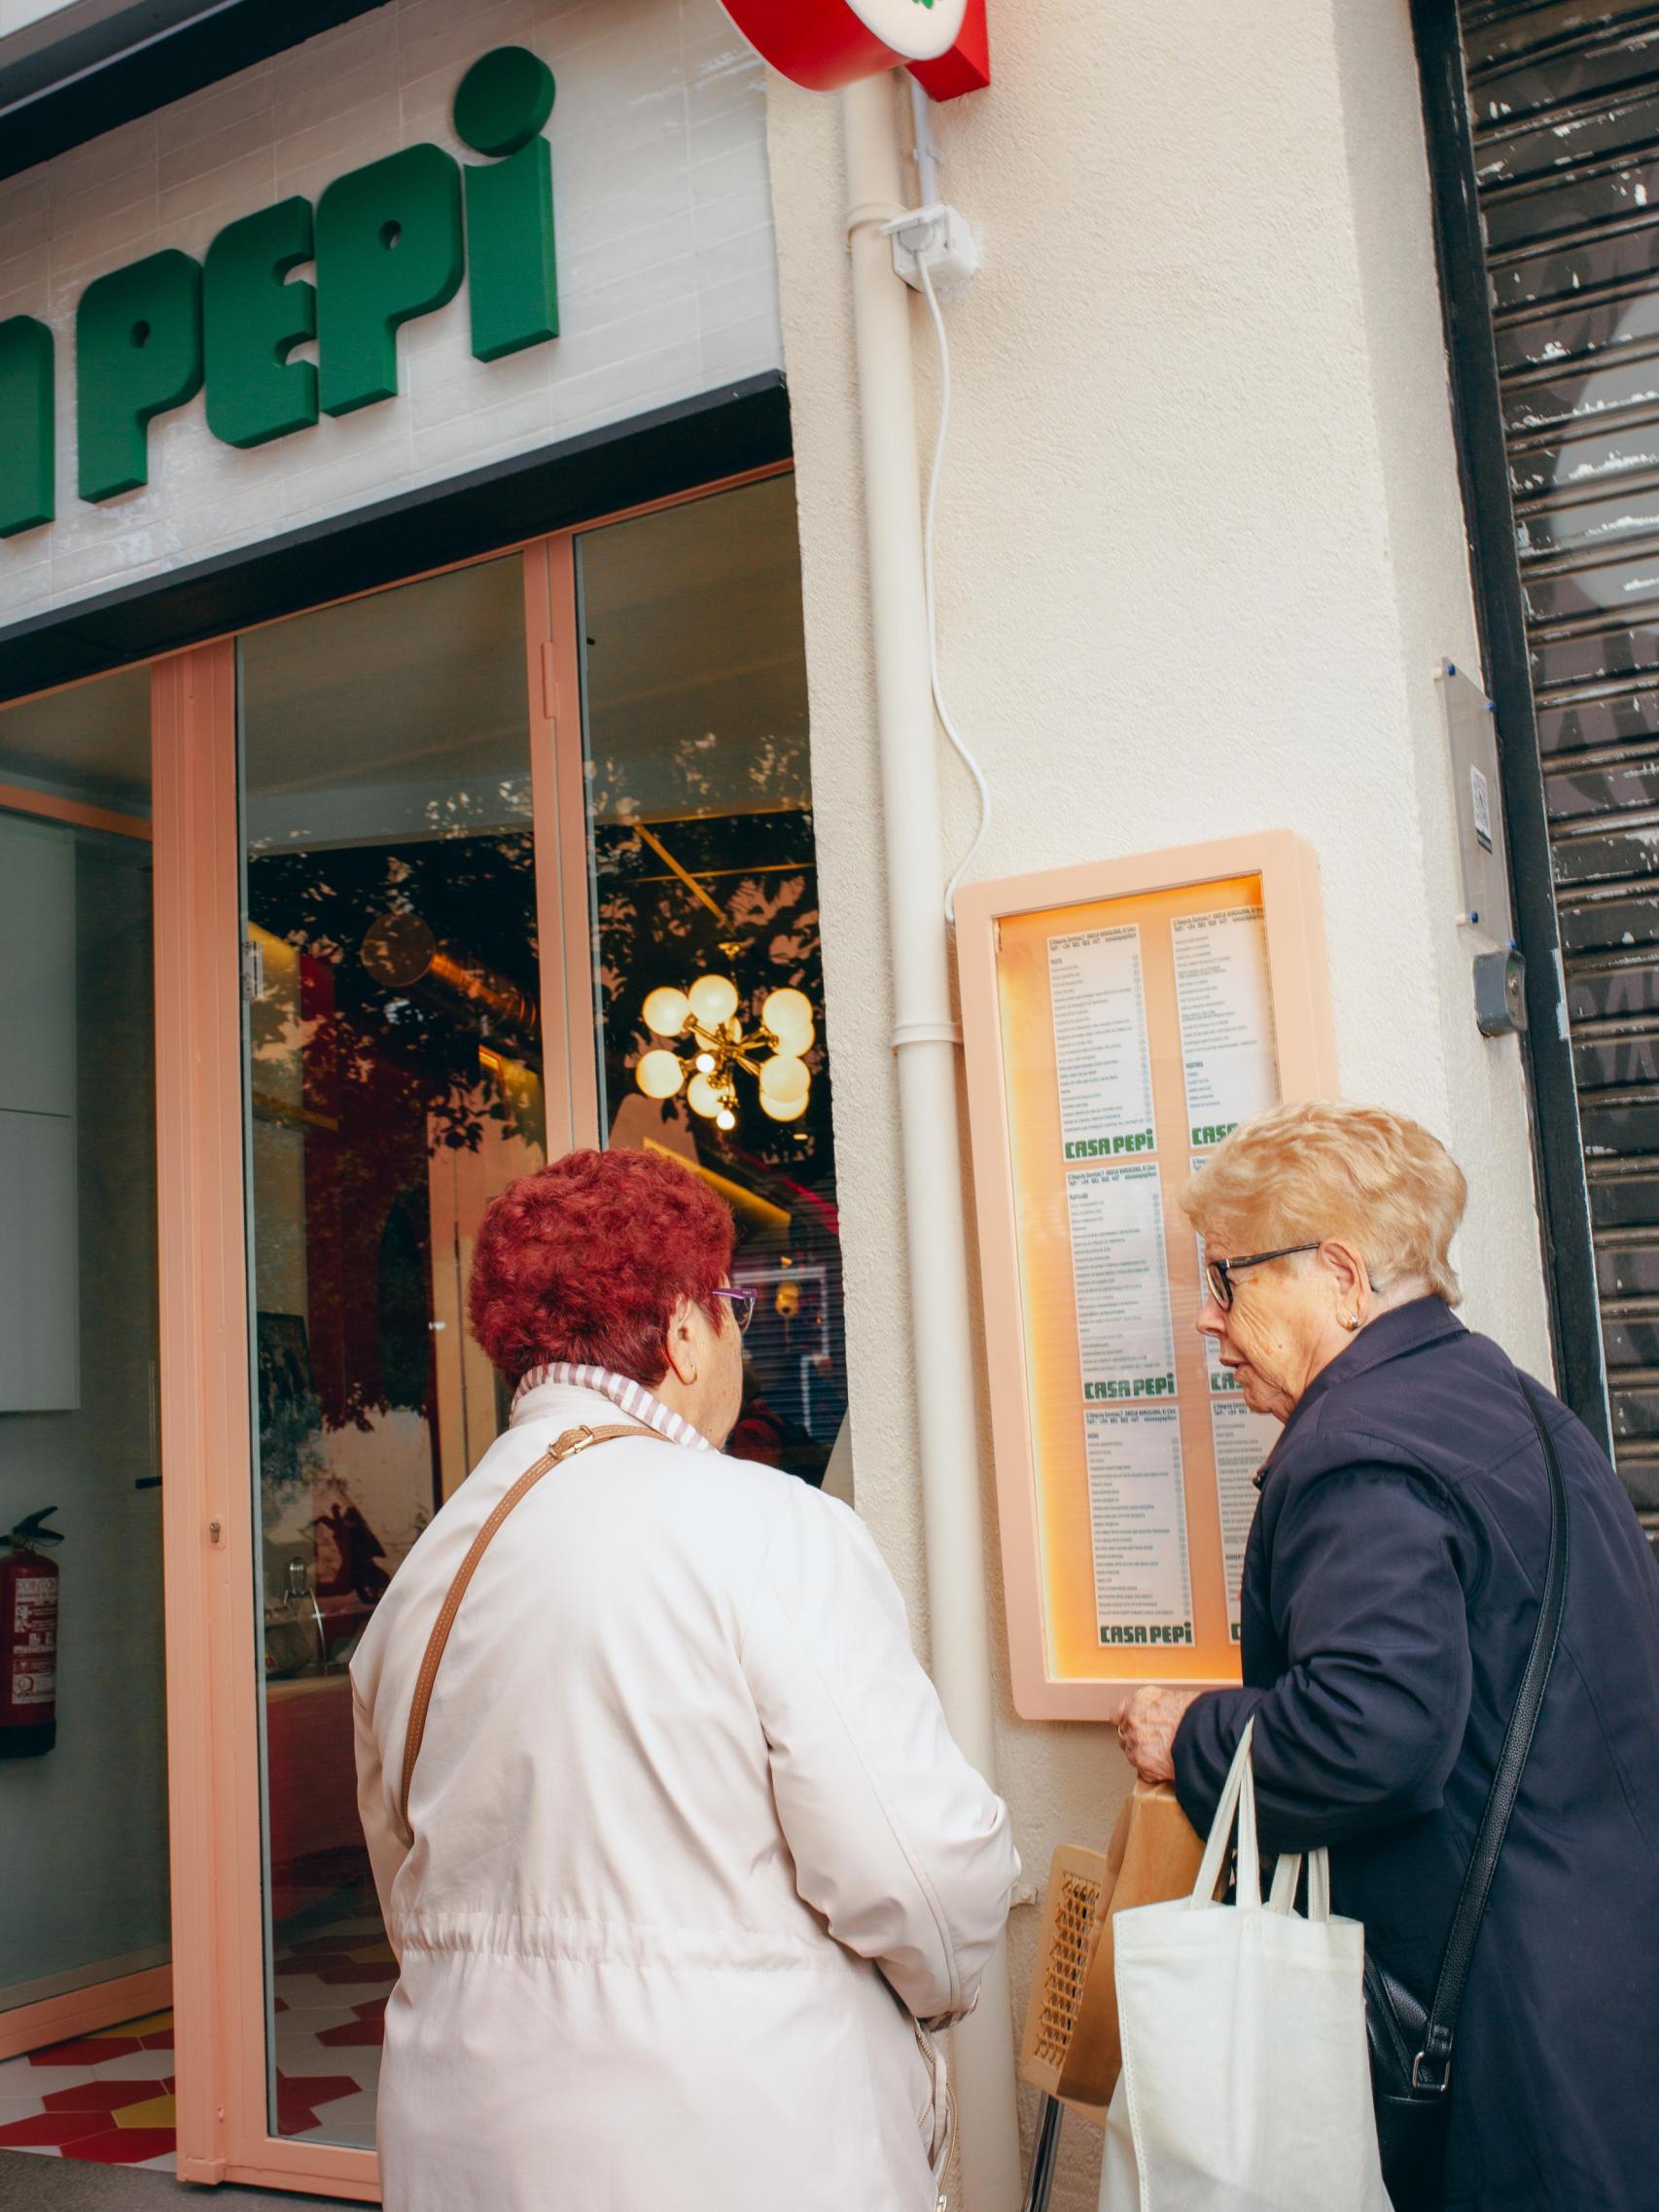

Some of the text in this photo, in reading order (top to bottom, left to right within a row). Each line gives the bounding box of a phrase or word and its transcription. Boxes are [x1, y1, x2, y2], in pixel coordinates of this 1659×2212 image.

[1065, 1138, 1111, 1159] CASA
[1084, 1380, 1130, 1399] CASA
[1100, 1626, 1147, 1643] CASA
